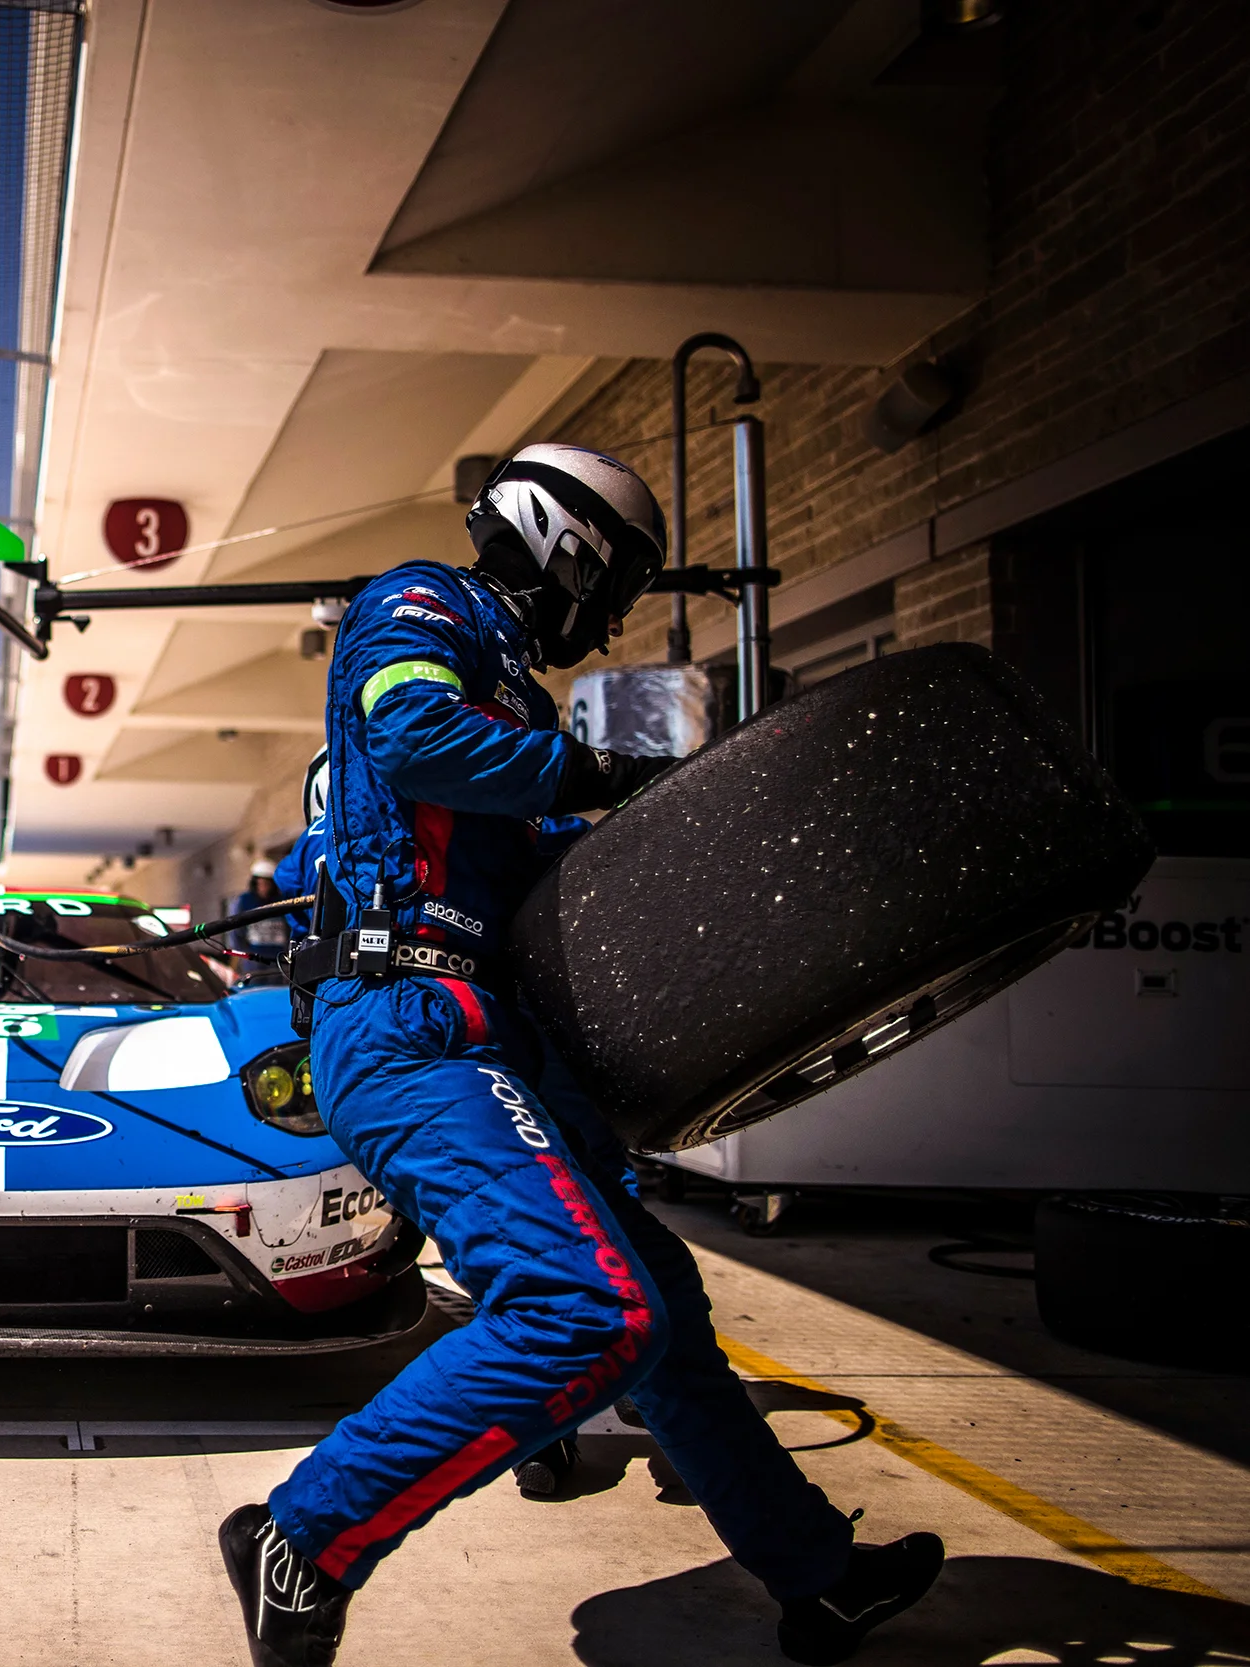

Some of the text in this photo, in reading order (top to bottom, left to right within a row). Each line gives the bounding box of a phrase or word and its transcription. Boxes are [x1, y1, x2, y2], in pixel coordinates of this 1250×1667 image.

[134, 507, 160, 557] 3
[412, 665, 440, 676] PIT
[80, 681, 100, 710] 2
[424, 901, 483, 937] sparco
[393, 944, 476, 980] parco
[477, 1067, 550, 1149] FORD
[175, 1194, 206, 1208] TOW
[320, 1186, 386, 1228] Eco
[285, 1250, 326, 1272] Castrol
